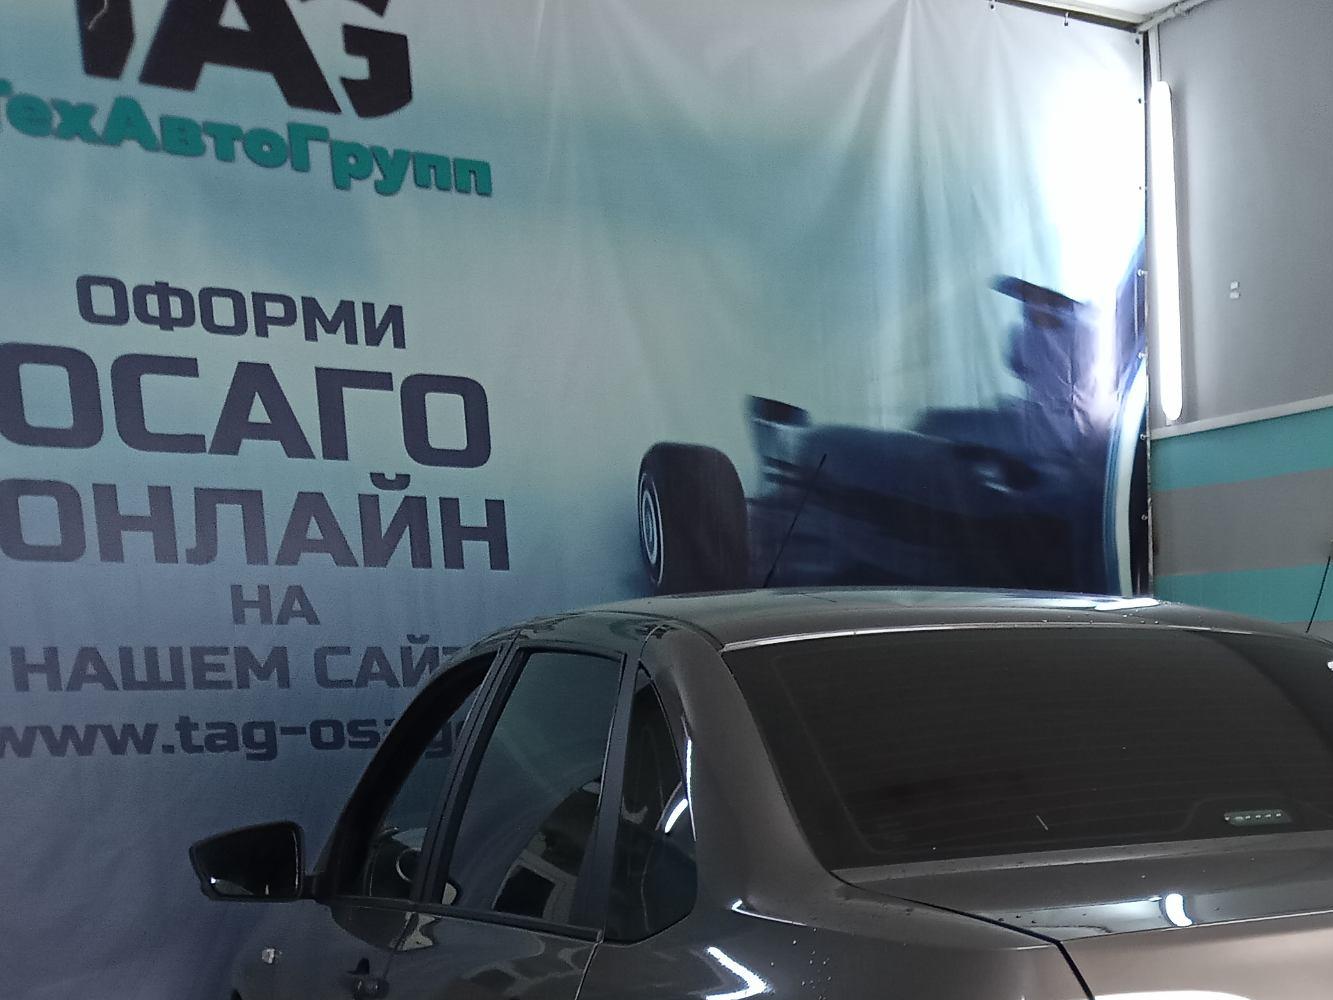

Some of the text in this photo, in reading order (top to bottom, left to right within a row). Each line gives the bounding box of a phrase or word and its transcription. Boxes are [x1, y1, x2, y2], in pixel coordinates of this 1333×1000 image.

[0, 79, 493, 196] ехАвтоГрупп
[76, 274, 407, 349] ОФОРМИ
[0, 342, 493, 468] ОСАГО
[0, 473, 510, 571] ОНЛАЙН
[231, 585, 320, 625] НА
[11, 645, 290, 692] НАШЕМ
